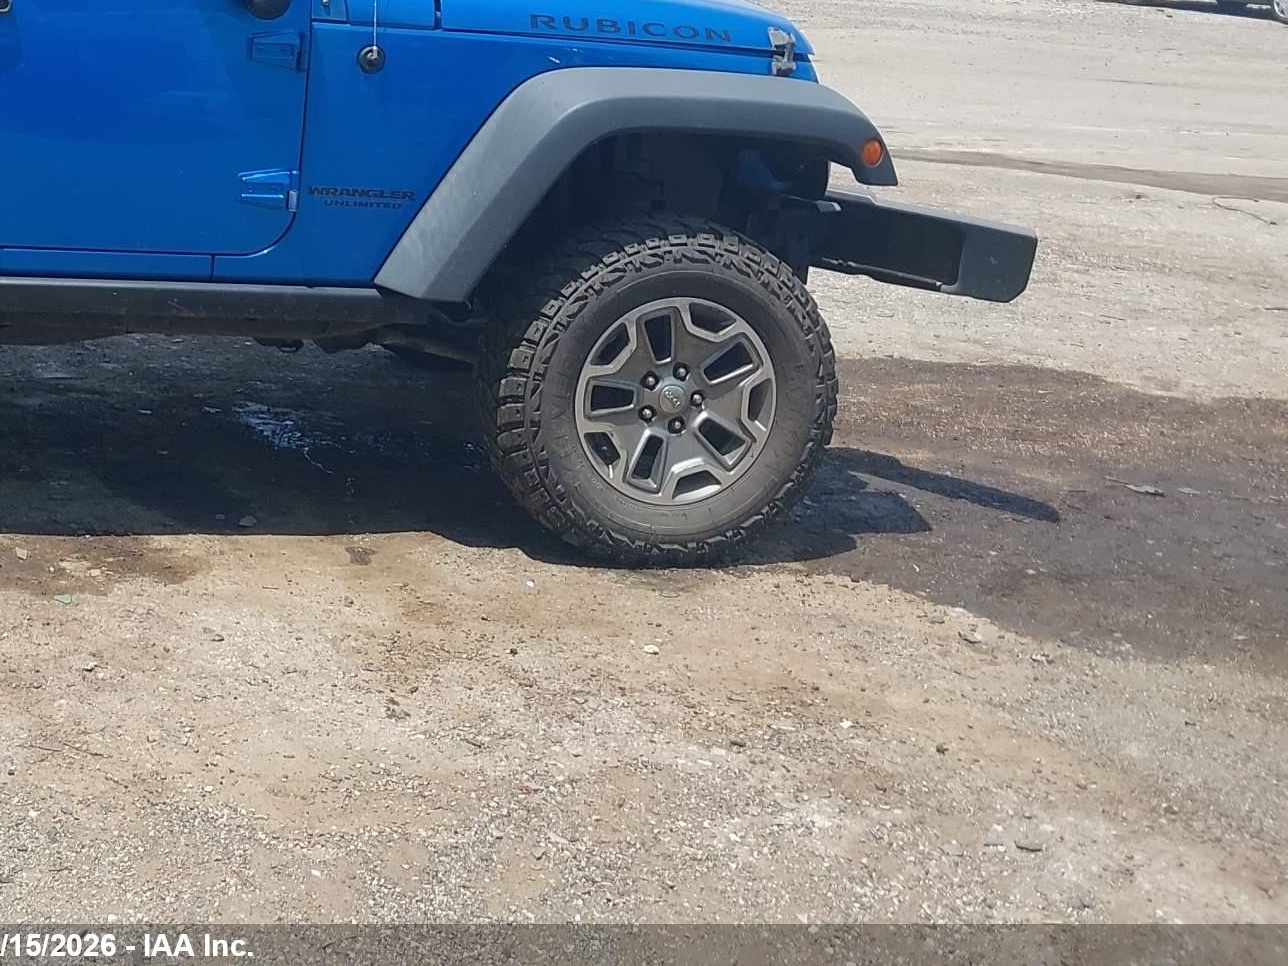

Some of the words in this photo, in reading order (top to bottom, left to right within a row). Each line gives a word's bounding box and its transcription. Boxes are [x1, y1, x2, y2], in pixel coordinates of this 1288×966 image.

[529, 13, 732, 43] RUBICON
[308, 186, 417, 201] WRANGLER
[323, 199, 402, 210] UNLIMITED
